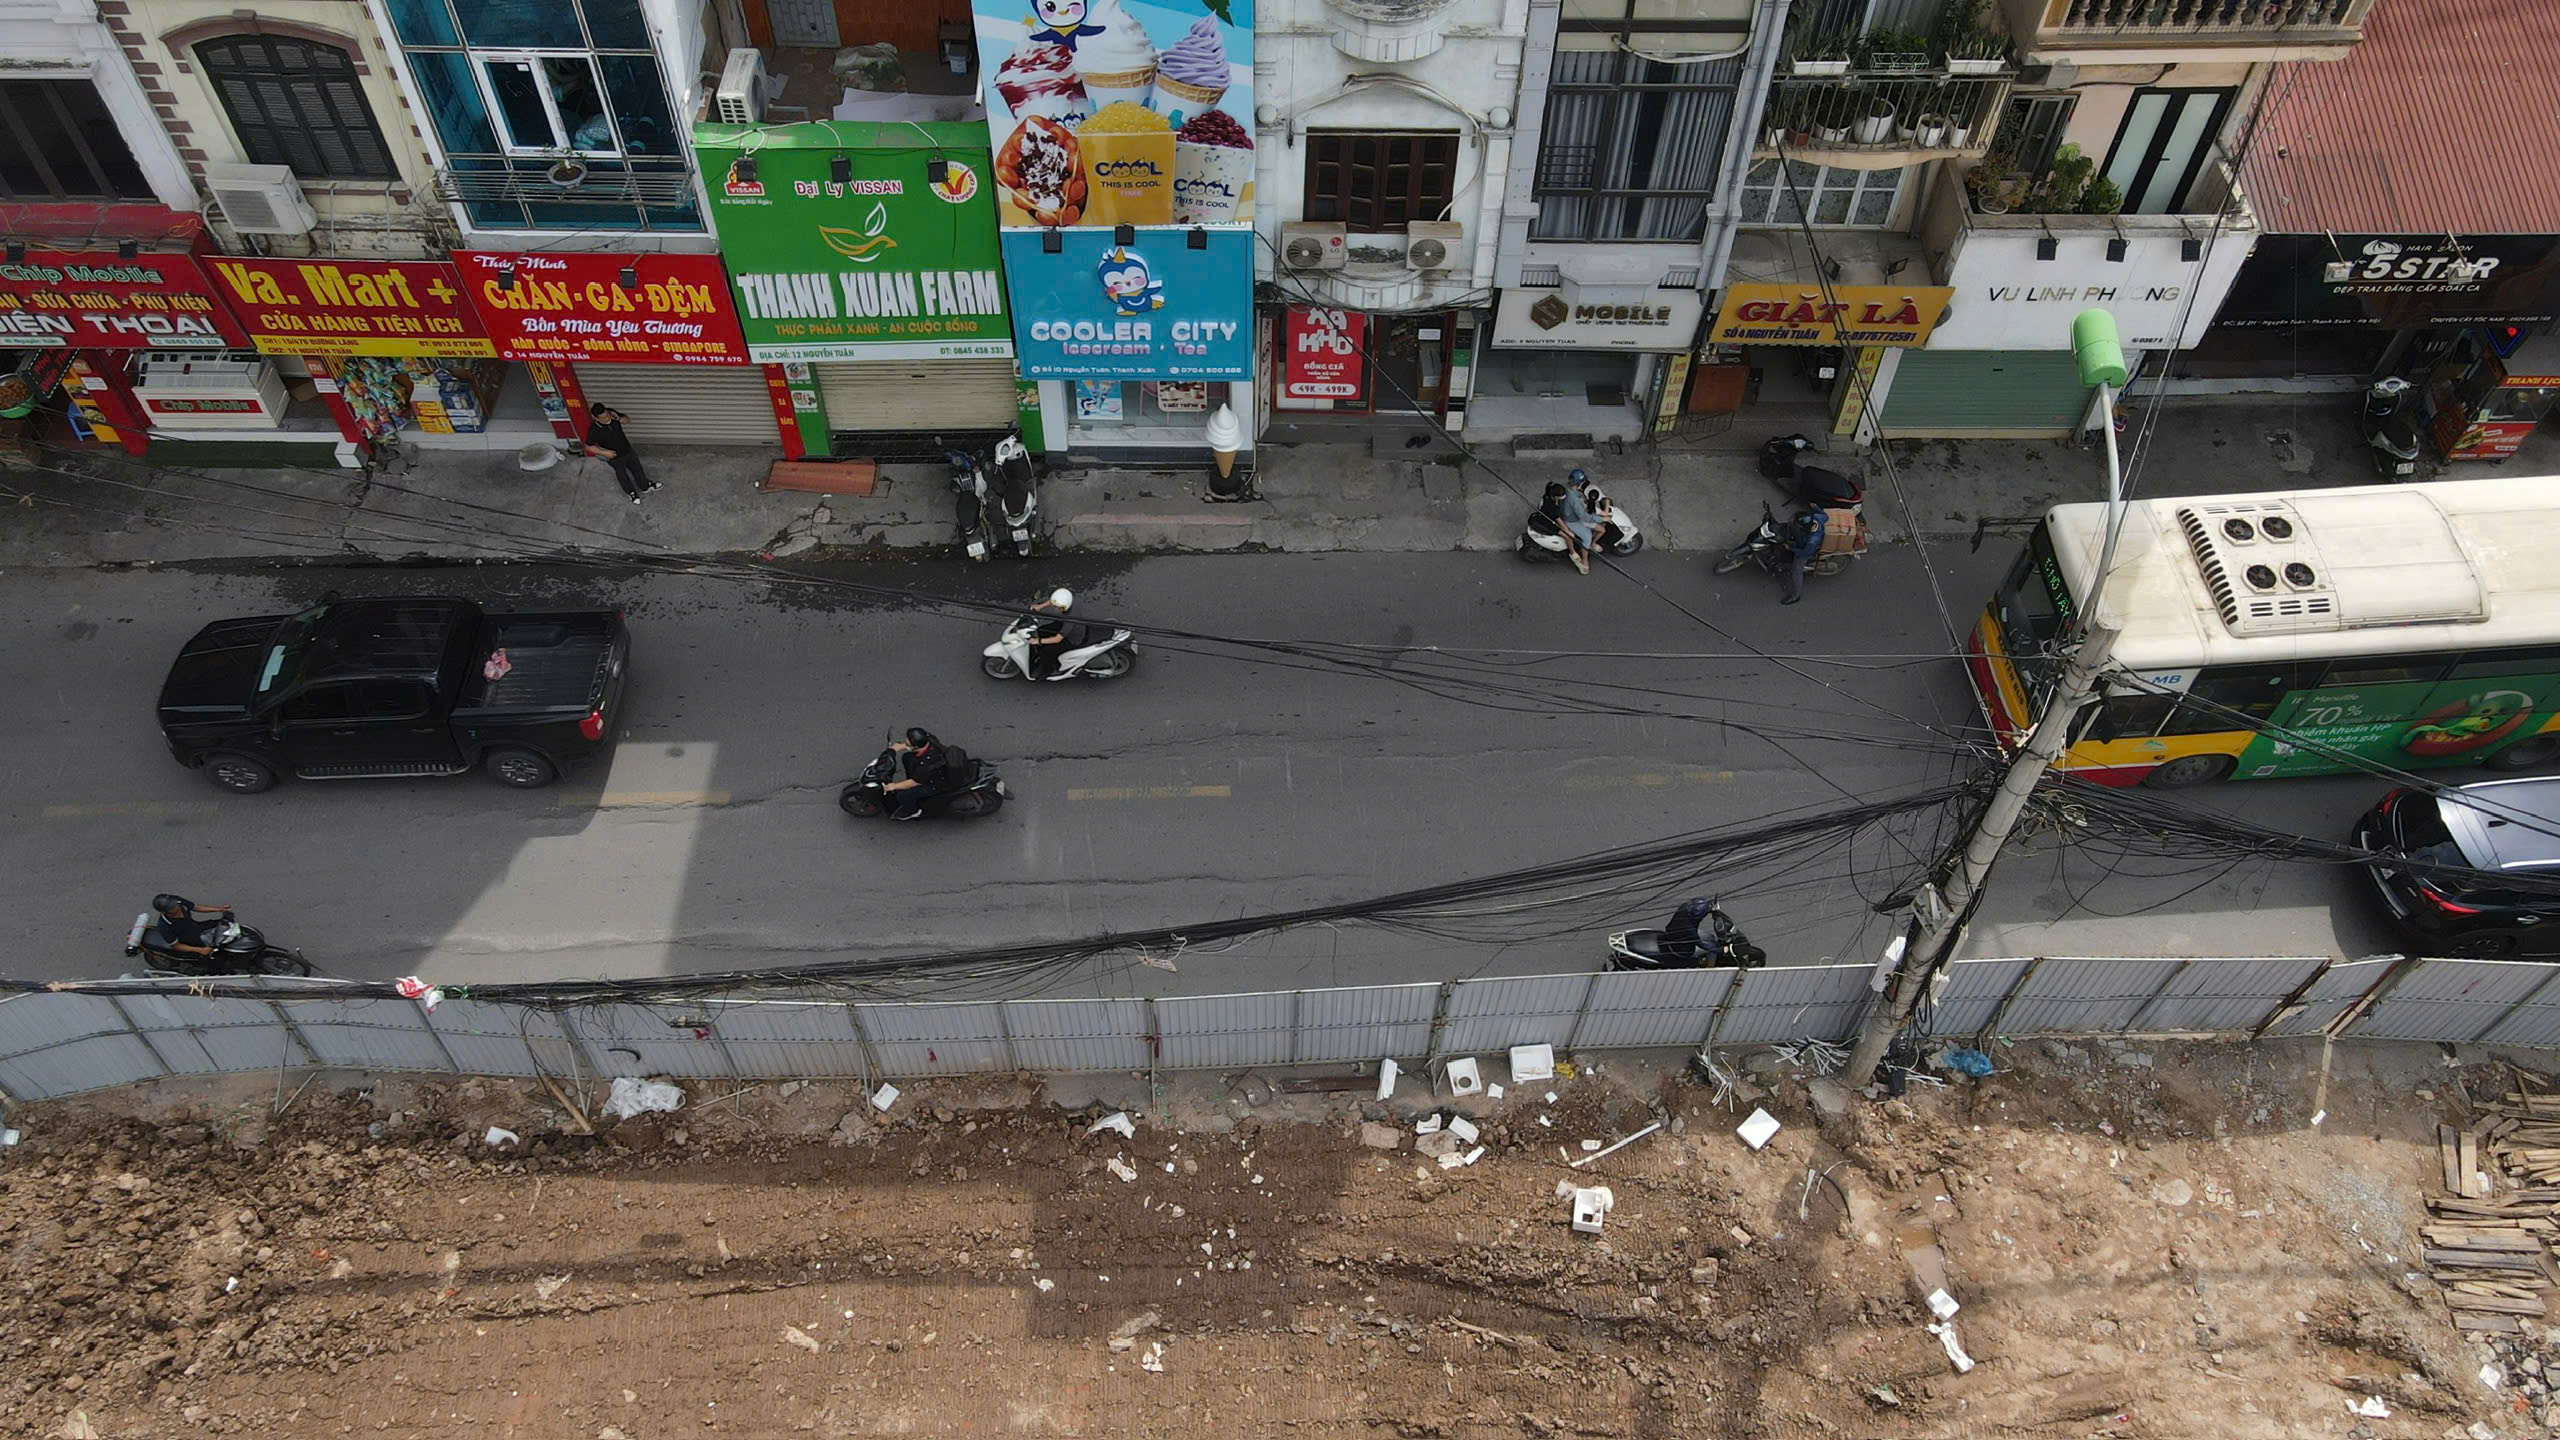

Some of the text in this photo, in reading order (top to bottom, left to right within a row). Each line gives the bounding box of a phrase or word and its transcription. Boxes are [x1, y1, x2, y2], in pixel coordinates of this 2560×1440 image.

[795, 181, 819, 198] Đại
[850, 180, 903, 195] VISSAN
[1135, 180, 1160, 188] COOL
[1195, 198, 1204, 206] IS
[1206, 199, 1229, 208] COOL
[0, 264, 164, 285] Chip Mobile
[216, 262, 301, 305] Va.
[297, 264, 420, 308] Mart
[736, 270, 1001, 318] THANH XUAN FARM
[2026, 286, 2077, 302] LINH
[484, 273, 716, 318] CHĂN GA ĐỆM
[1575, 305, 1671, 320] MOBILE
[1736, 291, 1921, 329] GIẶT LÀ
[82, 313, 217, 337] THOẠI
[260, 309, 309, 331] CỬA
[308, 312, 371, 332] HÀNG
[371, 313, 424, 335] TIỆN
[560, 319, 602, 334] Mùa
[606, 320, 640, 338] Yêu
[642, 320, 703, 338] Thương
[775, 323, 806, 336] THỰC
[847, 322, 880, 335] XANH
[889, 323, 905, 334] AN
[908, 319, 942, 334] CUỘC
[945, 317, 979, 333] SỐNG
[1030, 321, 1237, 341] COOLER CITY
[1745, 325, 1790, 339] NGUYỄN
[663, 341, 727, 354] SINGAPORE
[1174, 342, 1209, 356] Tea
[1298, 329, 1354, 355] KHO
[793, 350, 801, 358] 12
[1325, 385, 1348, 393] 499K
[2152, 674, 2182, 685] MB
